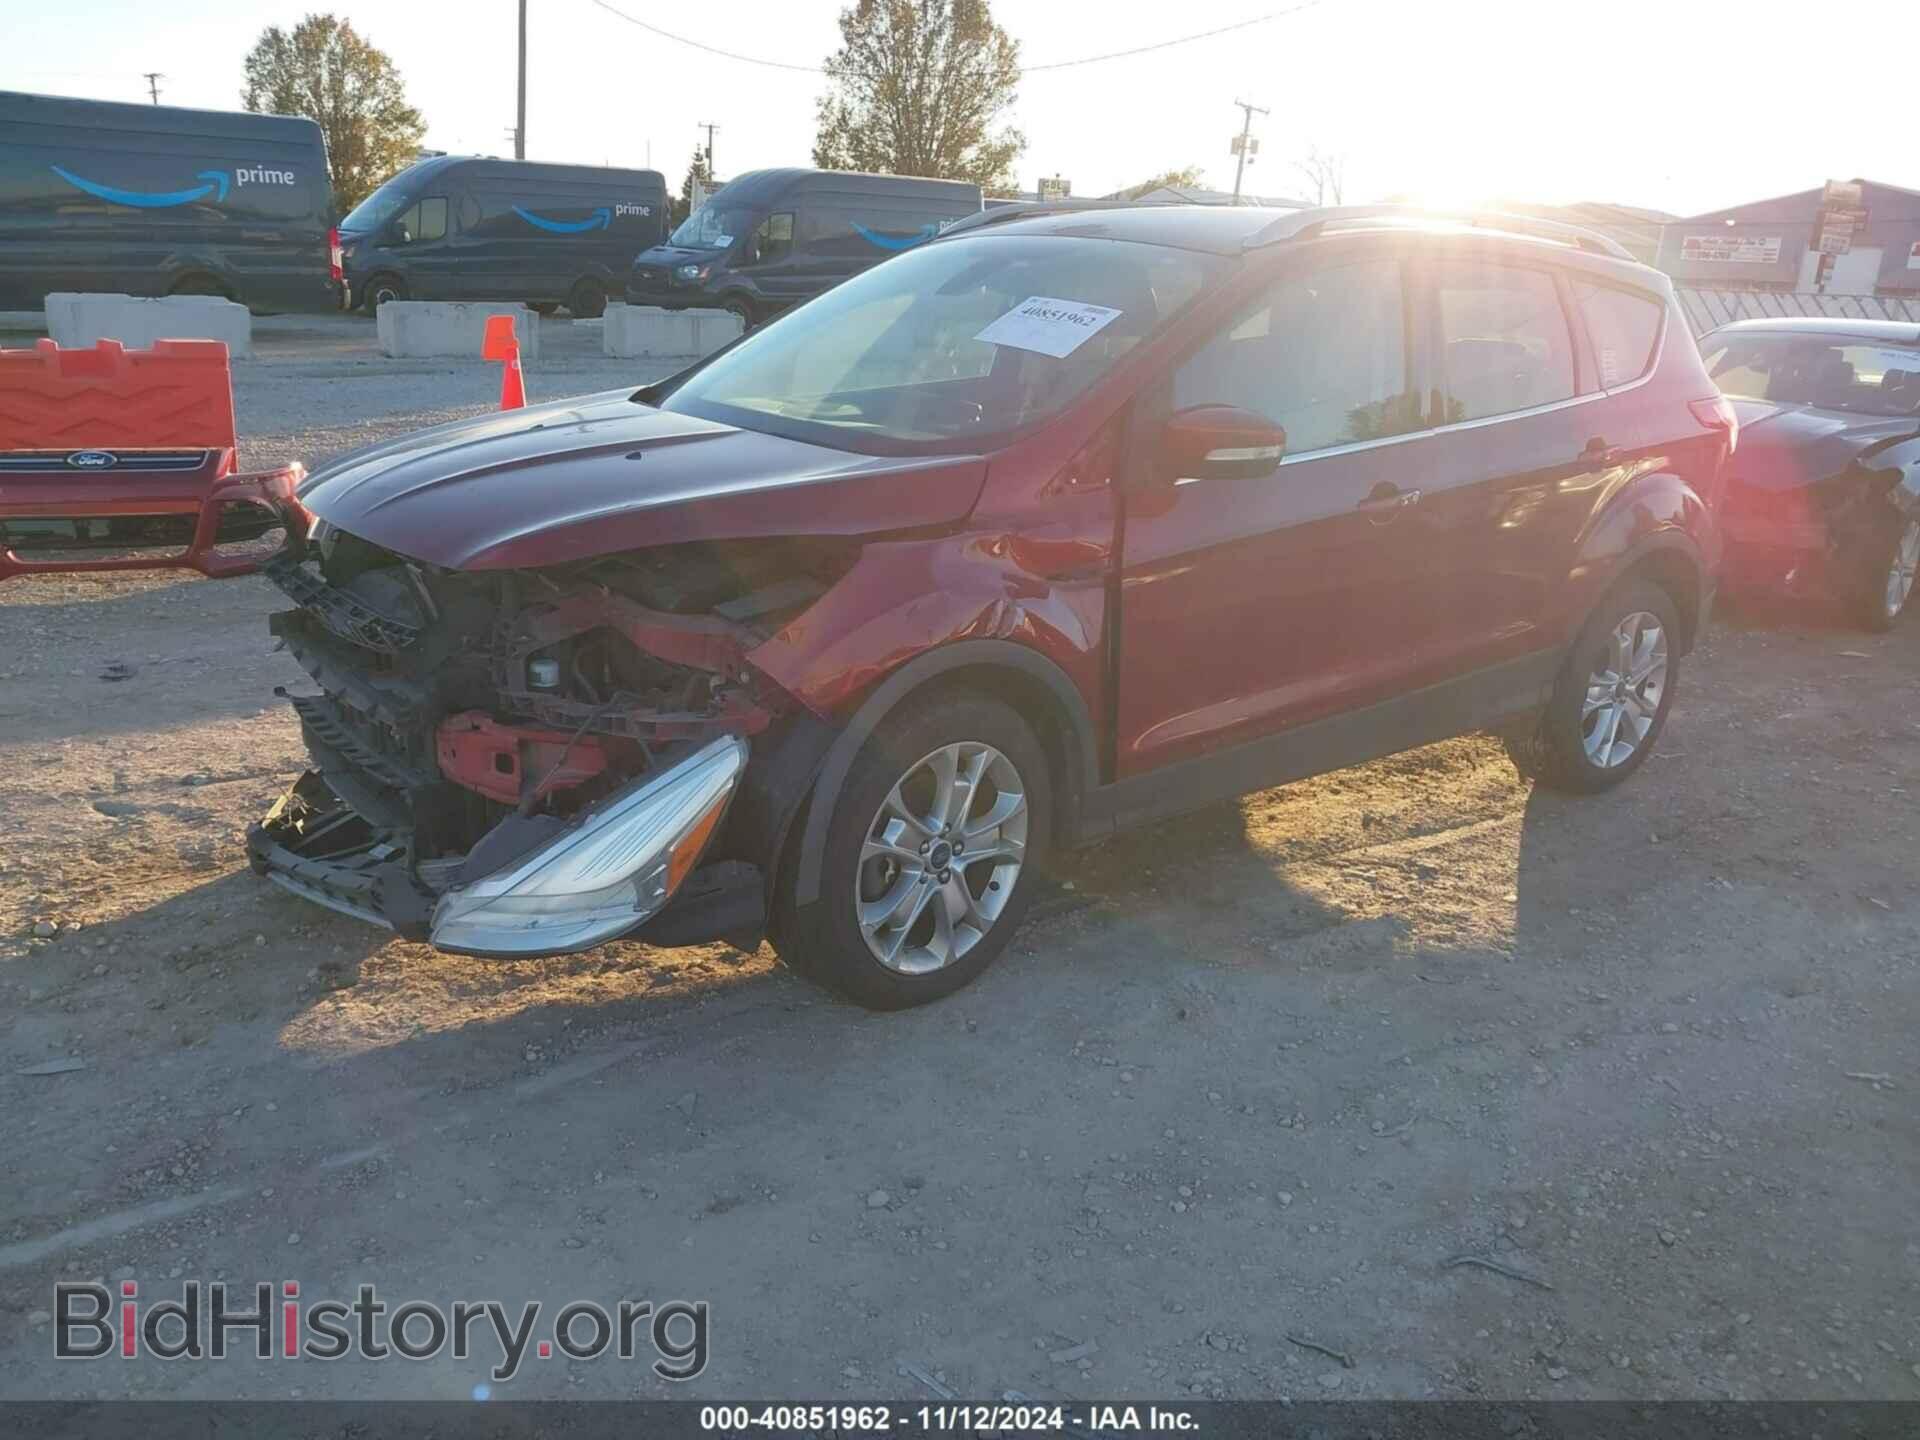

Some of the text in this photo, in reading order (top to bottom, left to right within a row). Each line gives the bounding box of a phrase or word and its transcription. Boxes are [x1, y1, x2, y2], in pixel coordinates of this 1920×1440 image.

[236, 164, 295, 187] prime
[615, 202, 652, 217] prime
[1020, 305, 1097, 326] 40851962
